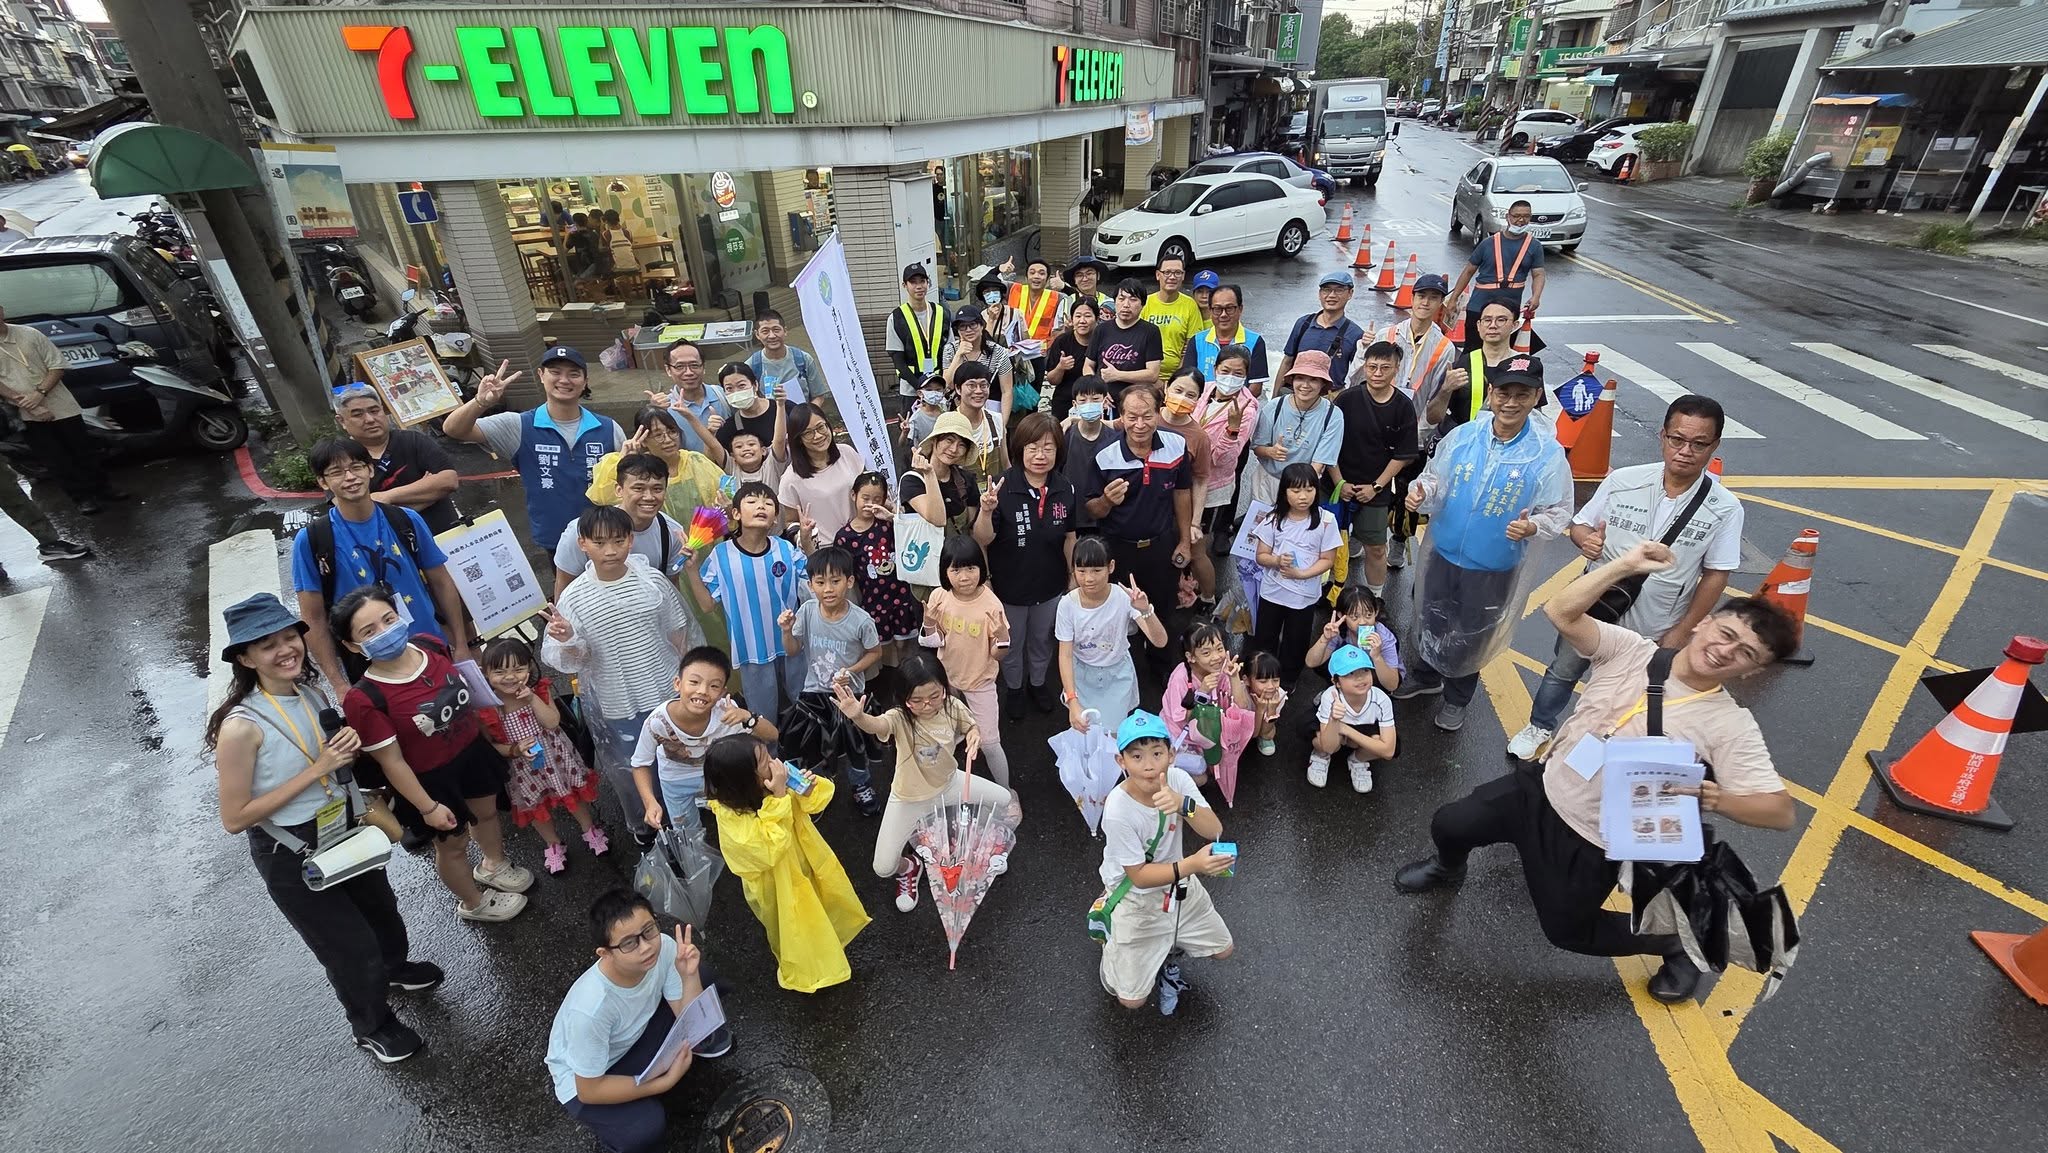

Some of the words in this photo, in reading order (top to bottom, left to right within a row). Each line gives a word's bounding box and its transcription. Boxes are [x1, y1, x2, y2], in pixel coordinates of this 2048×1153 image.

[1148, 315, 1172, 324] RUN
[1104, 343, 1133, 361] Click
[538, 454, 554, 489] 劉文豪
[1609, 515, 1648, 536] 張建鴻
[1948, 753, 1985, 806] 桃園市政府交通局
